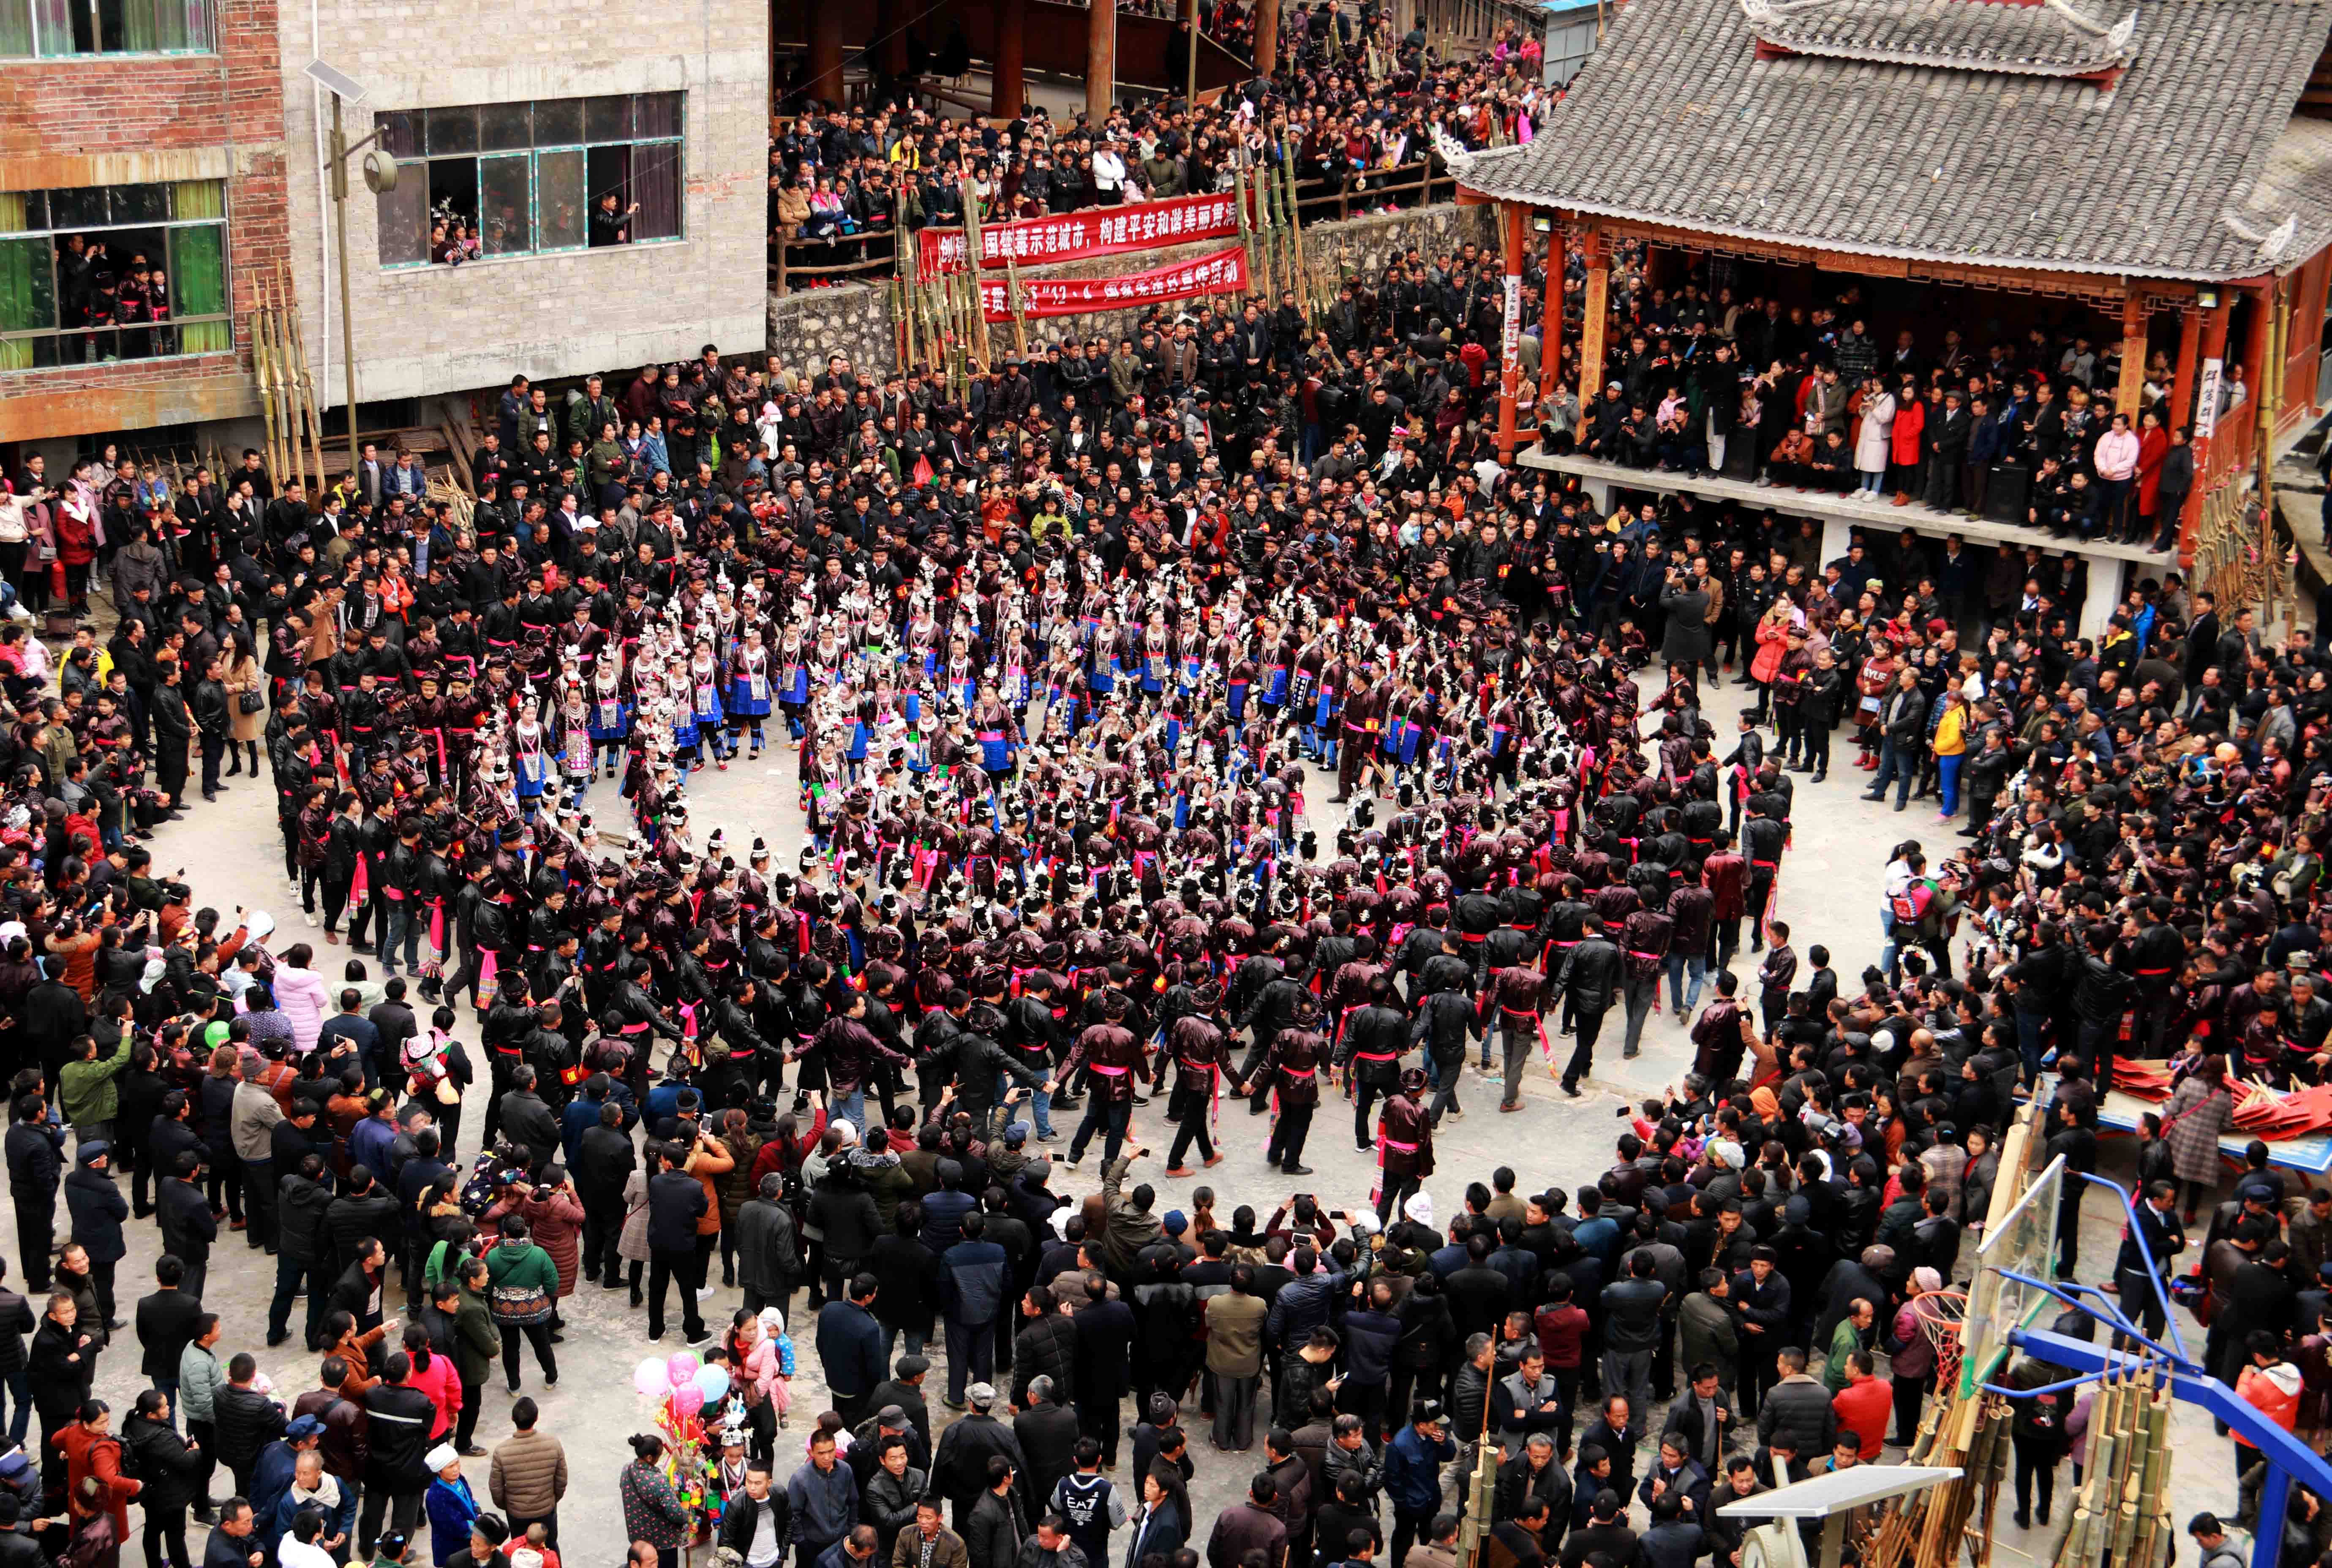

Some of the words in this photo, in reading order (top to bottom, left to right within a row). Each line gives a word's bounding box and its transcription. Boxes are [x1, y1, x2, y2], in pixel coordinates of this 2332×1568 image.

[940, 201, 1237, 263] 创建国禁毒示范城市，构建平安和谐美丽贯洞
[1067, 1496, 1097, 1510] EA7
